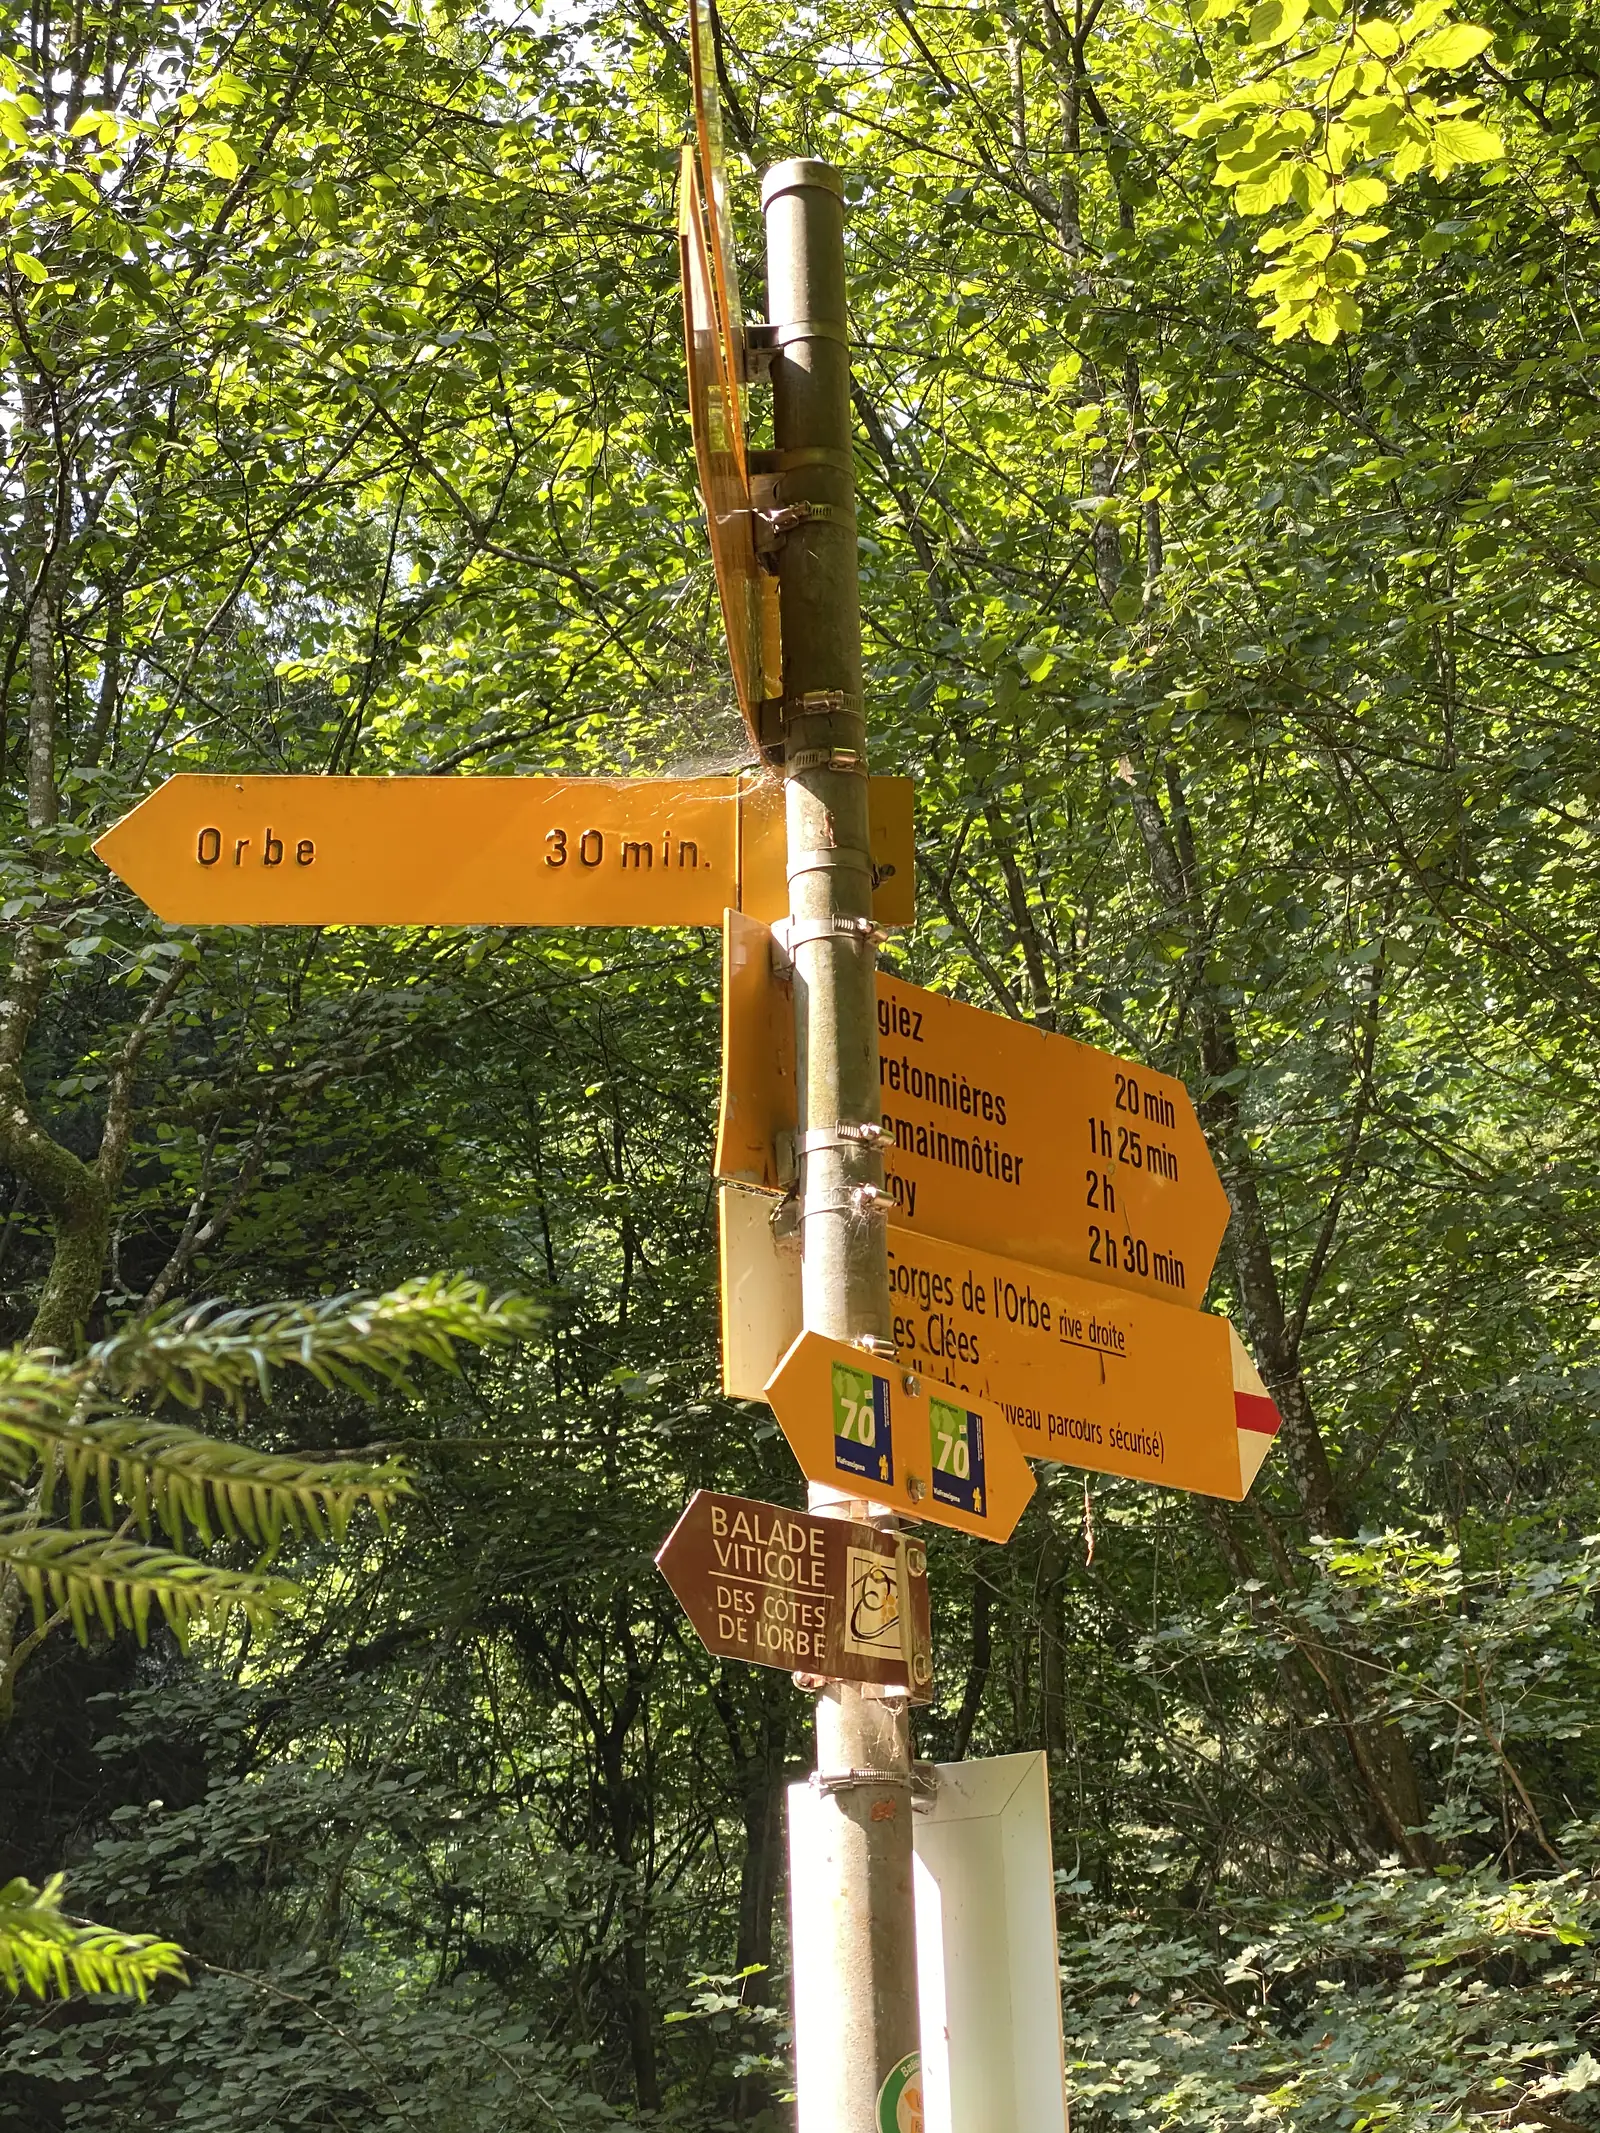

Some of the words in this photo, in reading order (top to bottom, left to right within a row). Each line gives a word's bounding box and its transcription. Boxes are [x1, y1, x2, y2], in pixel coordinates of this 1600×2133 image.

[197, 827, 316, 866] Orbe
[544, 828, 604, 867] 30
[621, 830, 712, 868] min.
[878, 994, 924, 1043] giez
[1115, 1073, 1139, 1115] 20
[1144, 1091, 1175, 1129] min
[880, 1055, 1007, 1126] retonnières
[881, 1114, 1023, 1186] omainmôtier
[885, 1170, 916, 1217] roy
[962, 1270, 986, 1315] de
[994, 1276, 1051, 1332] l'Orbe
[1060, 1309, 1082, 1339] rive
[1089, 1316, 1125, 1351] droite
[891, 1316, 915, 1349] es
[928, 1313, 979, 1365] Clées
[840, 1397, 875, 1447] 70
[994, 1401, 1041, 1431] uveau
[1048, 1413, 1103, 1445] parcours
[1110, 1422, 1164, 1464] sécurisé)
[937, 1431, 969, 1479] 70
[711, 1505, 825, 1557] BALADE
[713, 1539, 825, 1587] VITICOLE
[716, 1585, 755, 1614] DES
[763, 1592, 825, 1628] CÔTES
[718, 1613, 748, 1643] DE
[756, 1621, 826, 1659] L'ORBE
